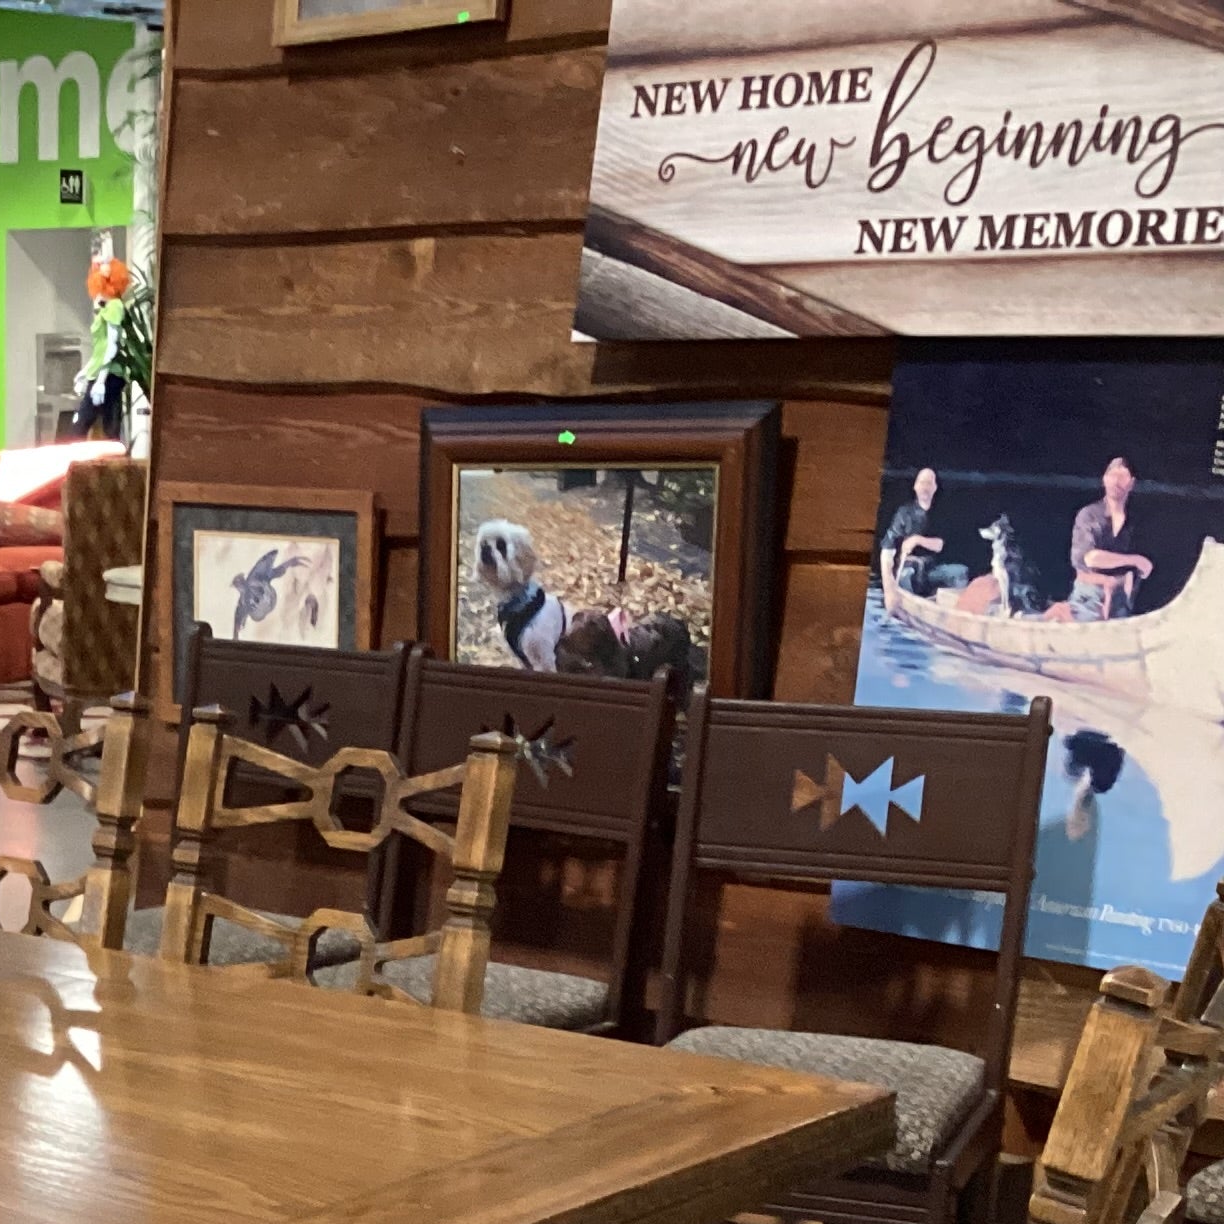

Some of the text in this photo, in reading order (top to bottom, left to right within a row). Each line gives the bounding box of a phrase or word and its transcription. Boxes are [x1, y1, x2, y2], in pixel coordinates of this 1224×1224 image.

[630, 67, 873, 118] NEW HOME
[658, 38, 1224, 206] new beginning
[853, 216, 969, 255] NEW
